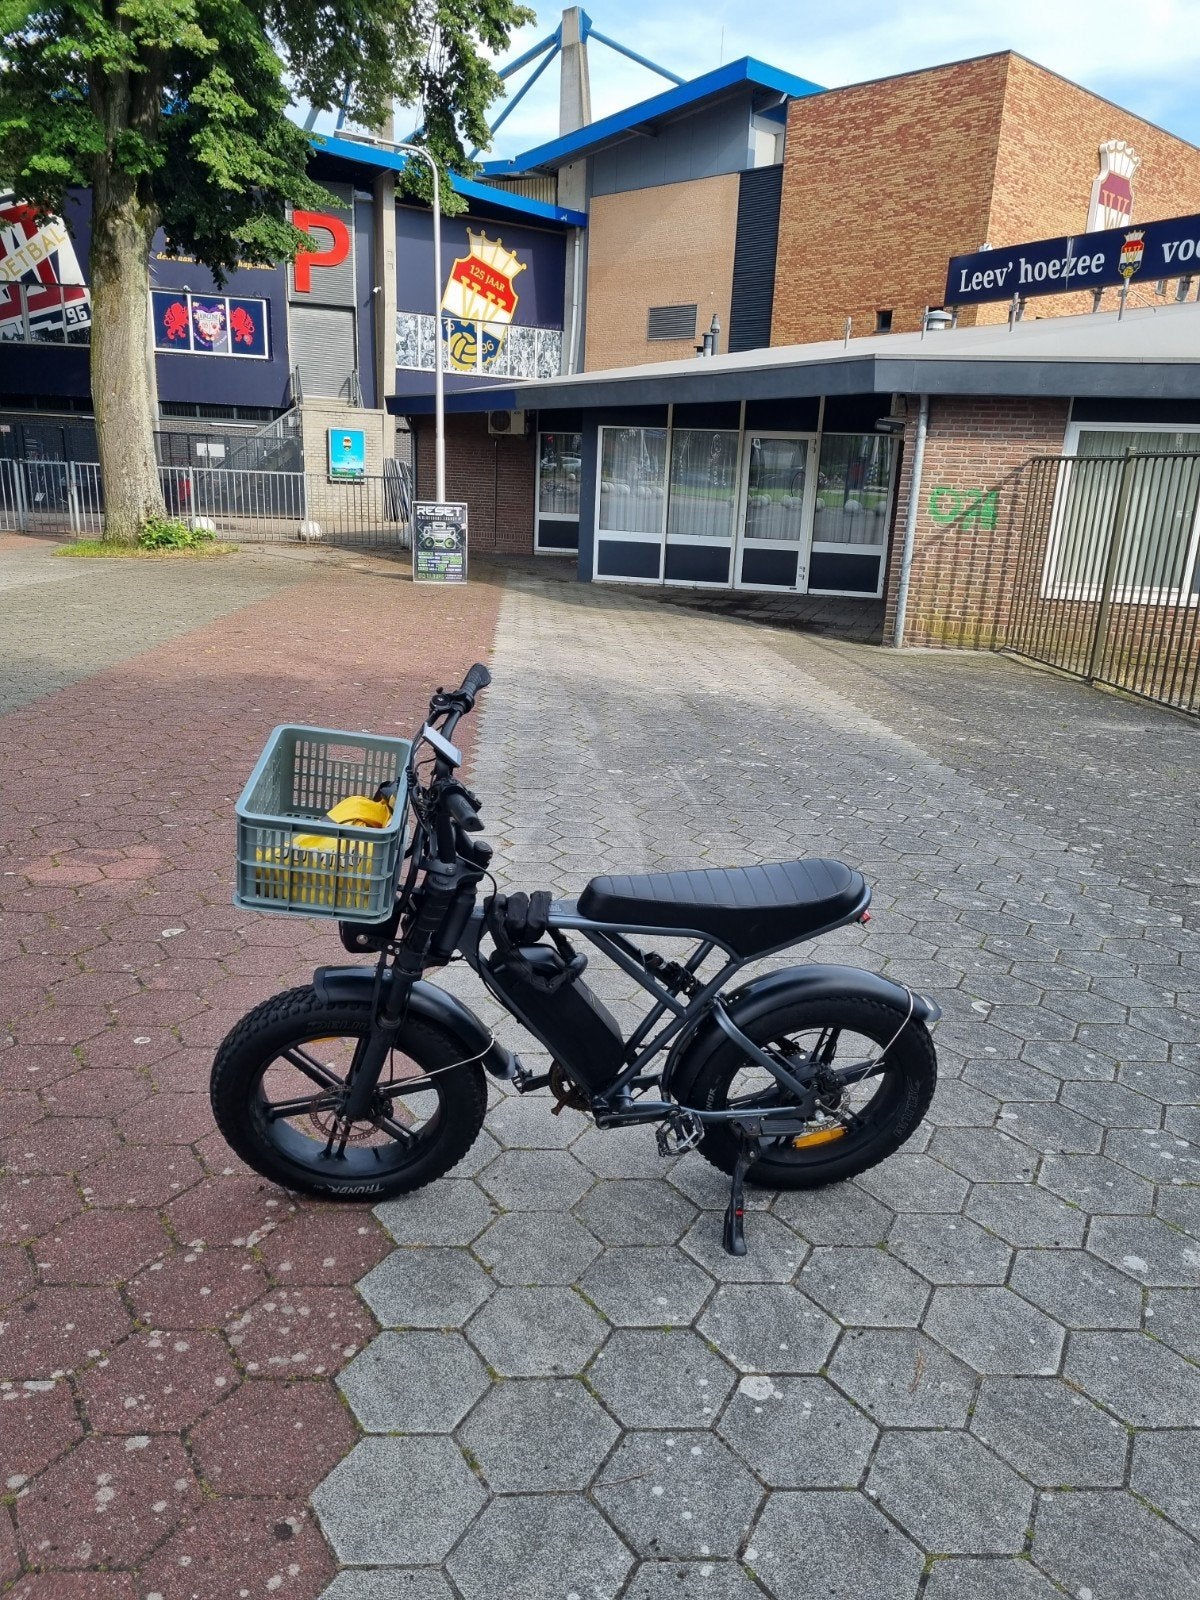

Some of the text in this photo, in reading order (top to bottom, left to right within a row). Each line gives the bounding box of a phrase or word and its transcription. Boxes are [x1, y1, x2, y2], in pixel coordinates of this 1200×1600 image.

[292, 209, 350, 293] P
[1161, 239, 1200, 263] vo
[469, 264, 506, 294] 125 JAAR
[1018, 252, 1105, 284] hoezee
[66, 305, 88, 324] 96
[416, 505, 463, 517] RESET
